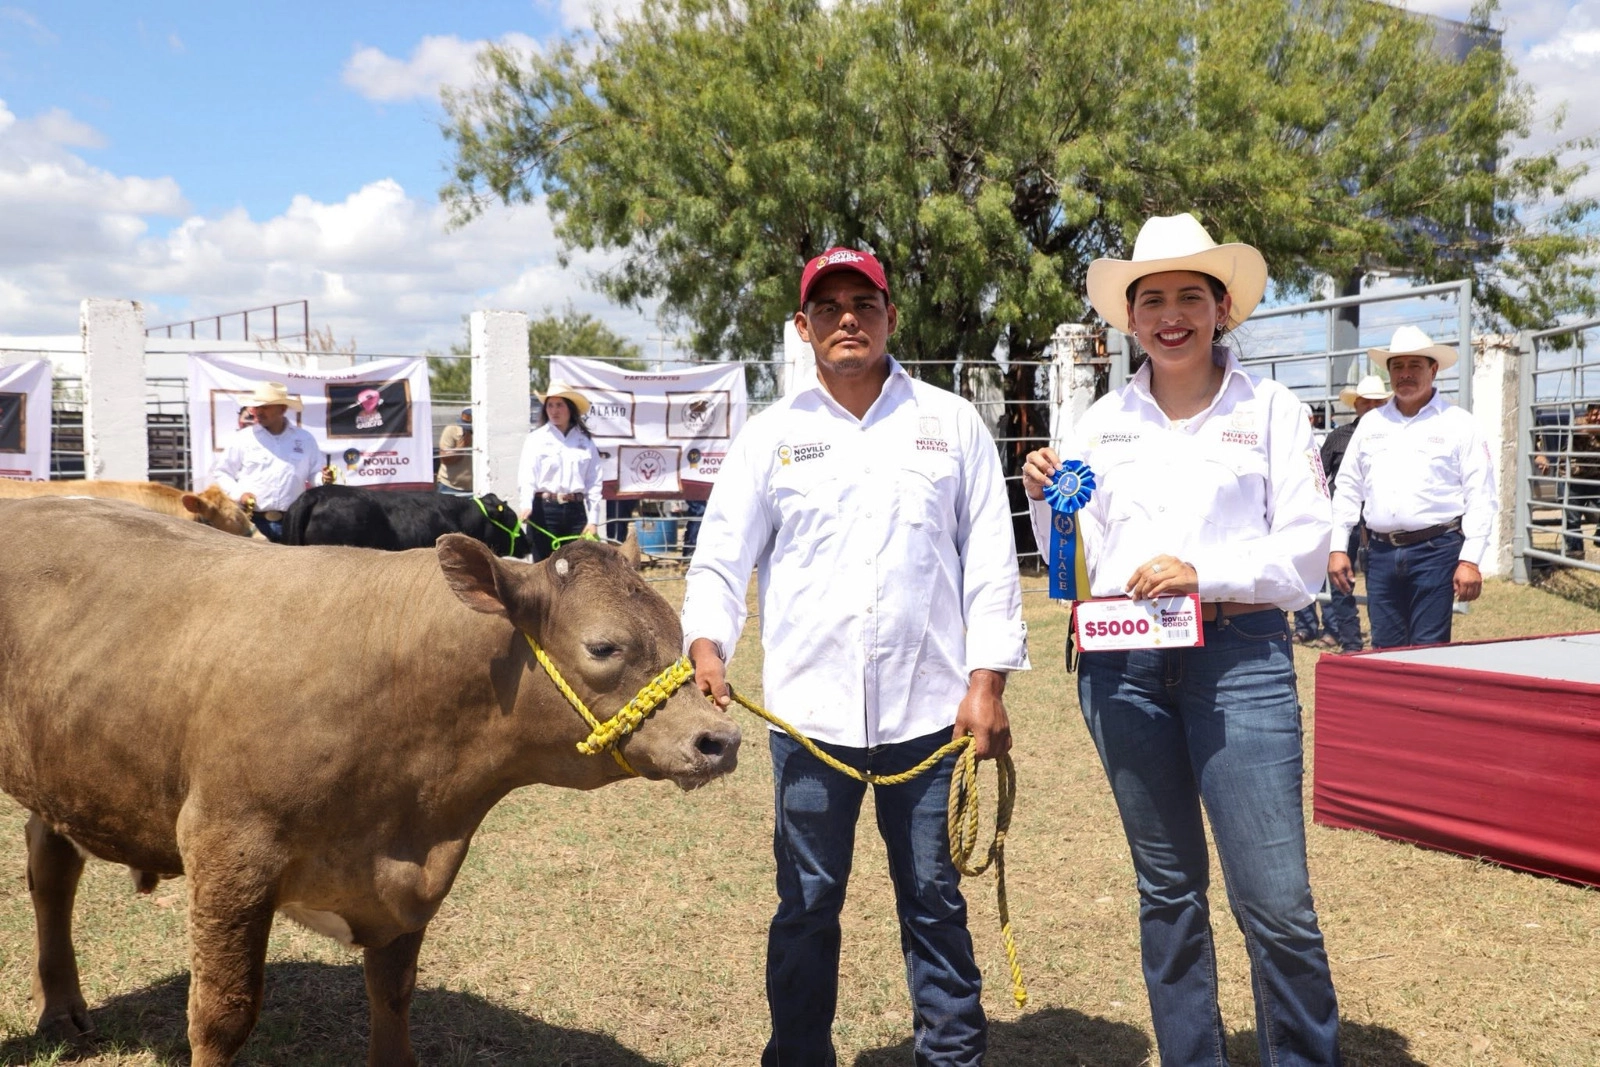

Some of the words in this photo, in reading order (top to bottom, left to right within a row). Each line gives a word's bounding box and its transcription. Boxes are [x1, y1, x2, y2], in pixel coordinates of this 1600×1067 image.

[590, 405, 626, 417] ALAMO
[1222, 431, 1258, 440] NUEVO
[916, 439, 948, 447] NUEVO
[794, 444, 831, 455] NOVILLO
[363, 457, 410, 466] NOVILLO
[794, 452, 824, 462] GORDO
[358, 467, 397, 477] GORDO
[699, 467, 720, 475] GOR
[1058, 539, 1068, 590] PLACE
[1162, 615, 1193, 623] NOVILLO
[1085, 619, 1149, 638] $5000
